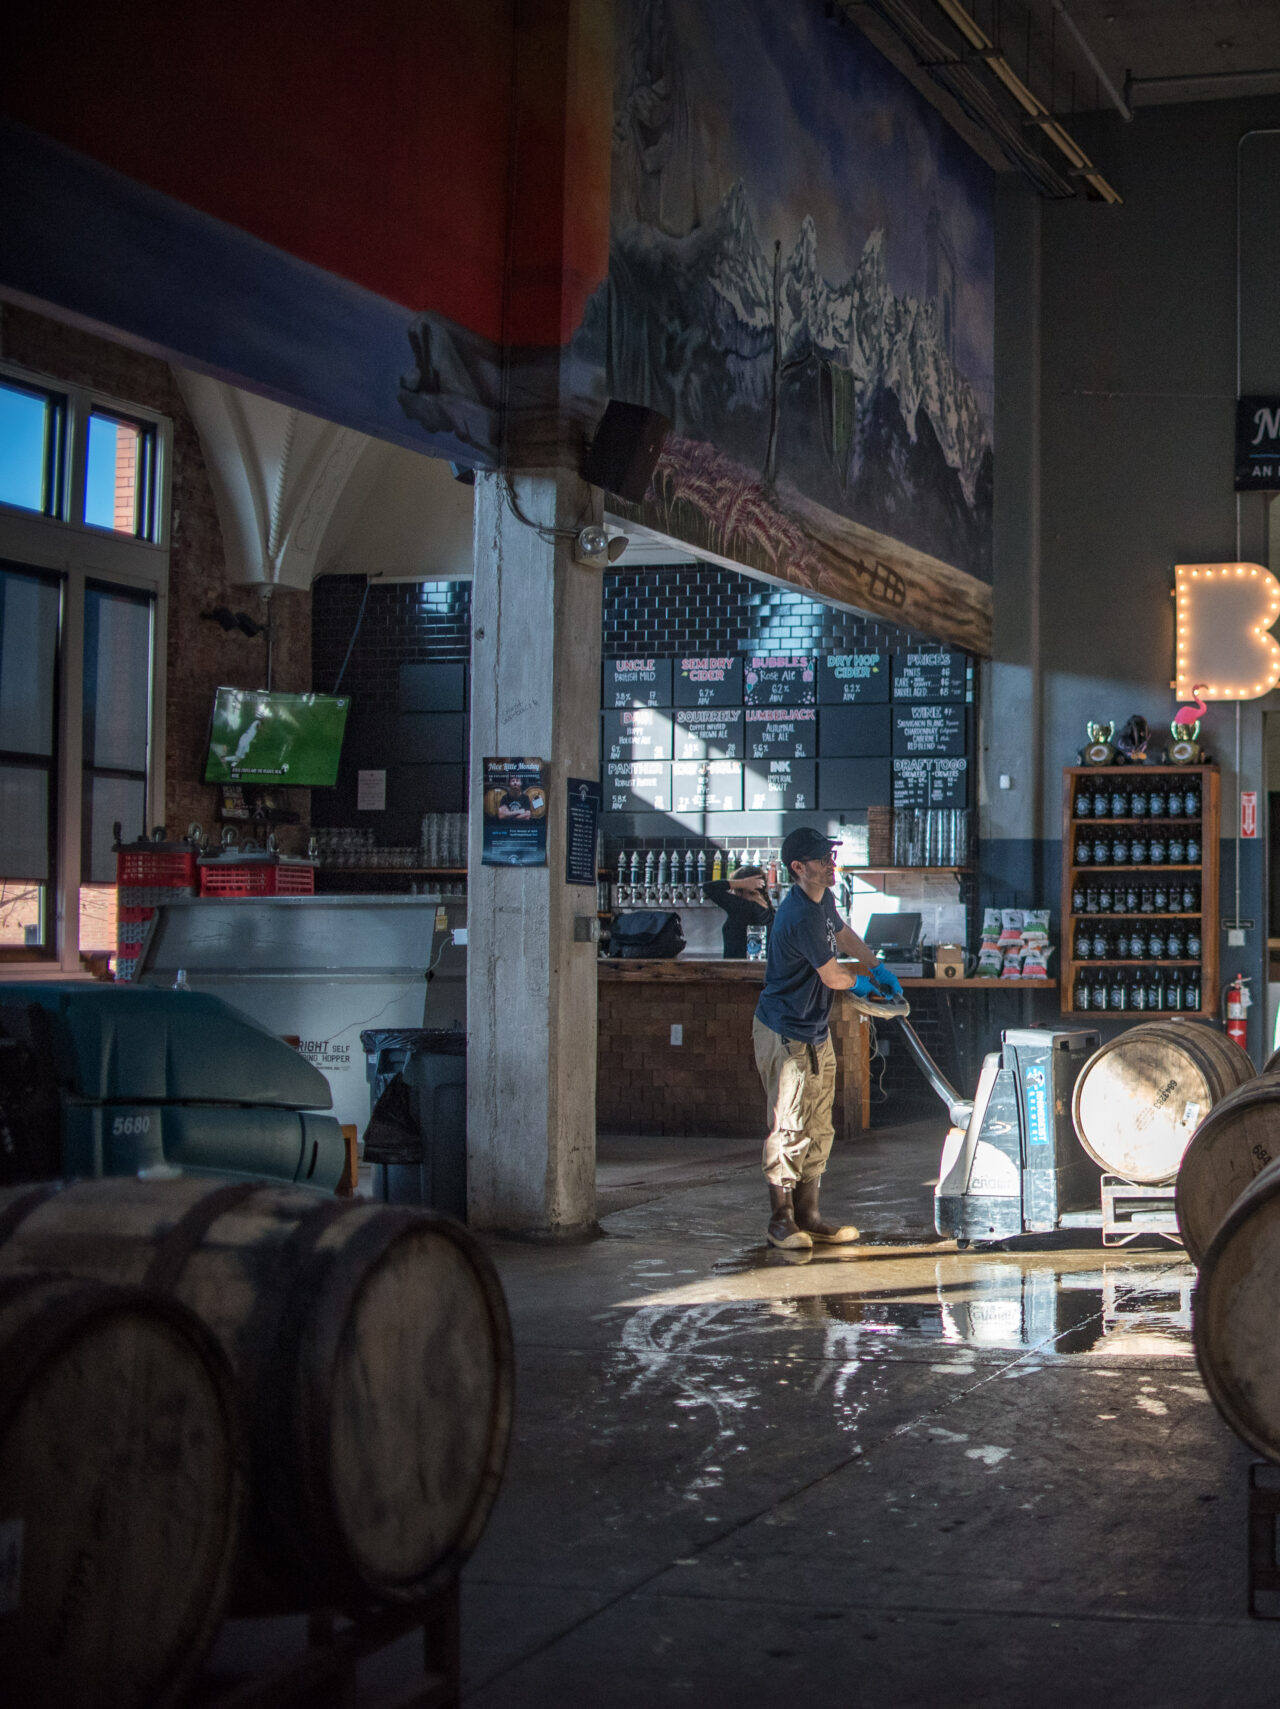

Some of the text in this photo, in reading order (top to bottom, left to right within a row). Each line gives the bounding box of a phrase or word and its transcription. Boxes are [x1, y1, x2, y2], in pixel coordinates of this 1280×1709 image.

[1252, 465, 1273, 477] AN
[616, 659, 656, 671] UNCLE
[681, 657, 735, 670] SEMI DRY
[752, 656, 808, 668] BUBBLES
[827, 654, 880, 668] DRY HOP
[907, 653, 951, 666] PRICES
[640, 671, 656, 682] MILD
[690, 670, 725, 682] CIDER
[834, 667, 871, 679] CIDER
[746, 708, 816, 722] LUMBERJACK
[912, 706, 942, 719] WINE
[762, 732, 790, 742] PALE ALE
[770, 760, 791, 773] INK
[894, 758, 933, 772] DRAFT
[332, 1045, 350, 1054] SELF
[112, 1116, 150, 1136] 5680
